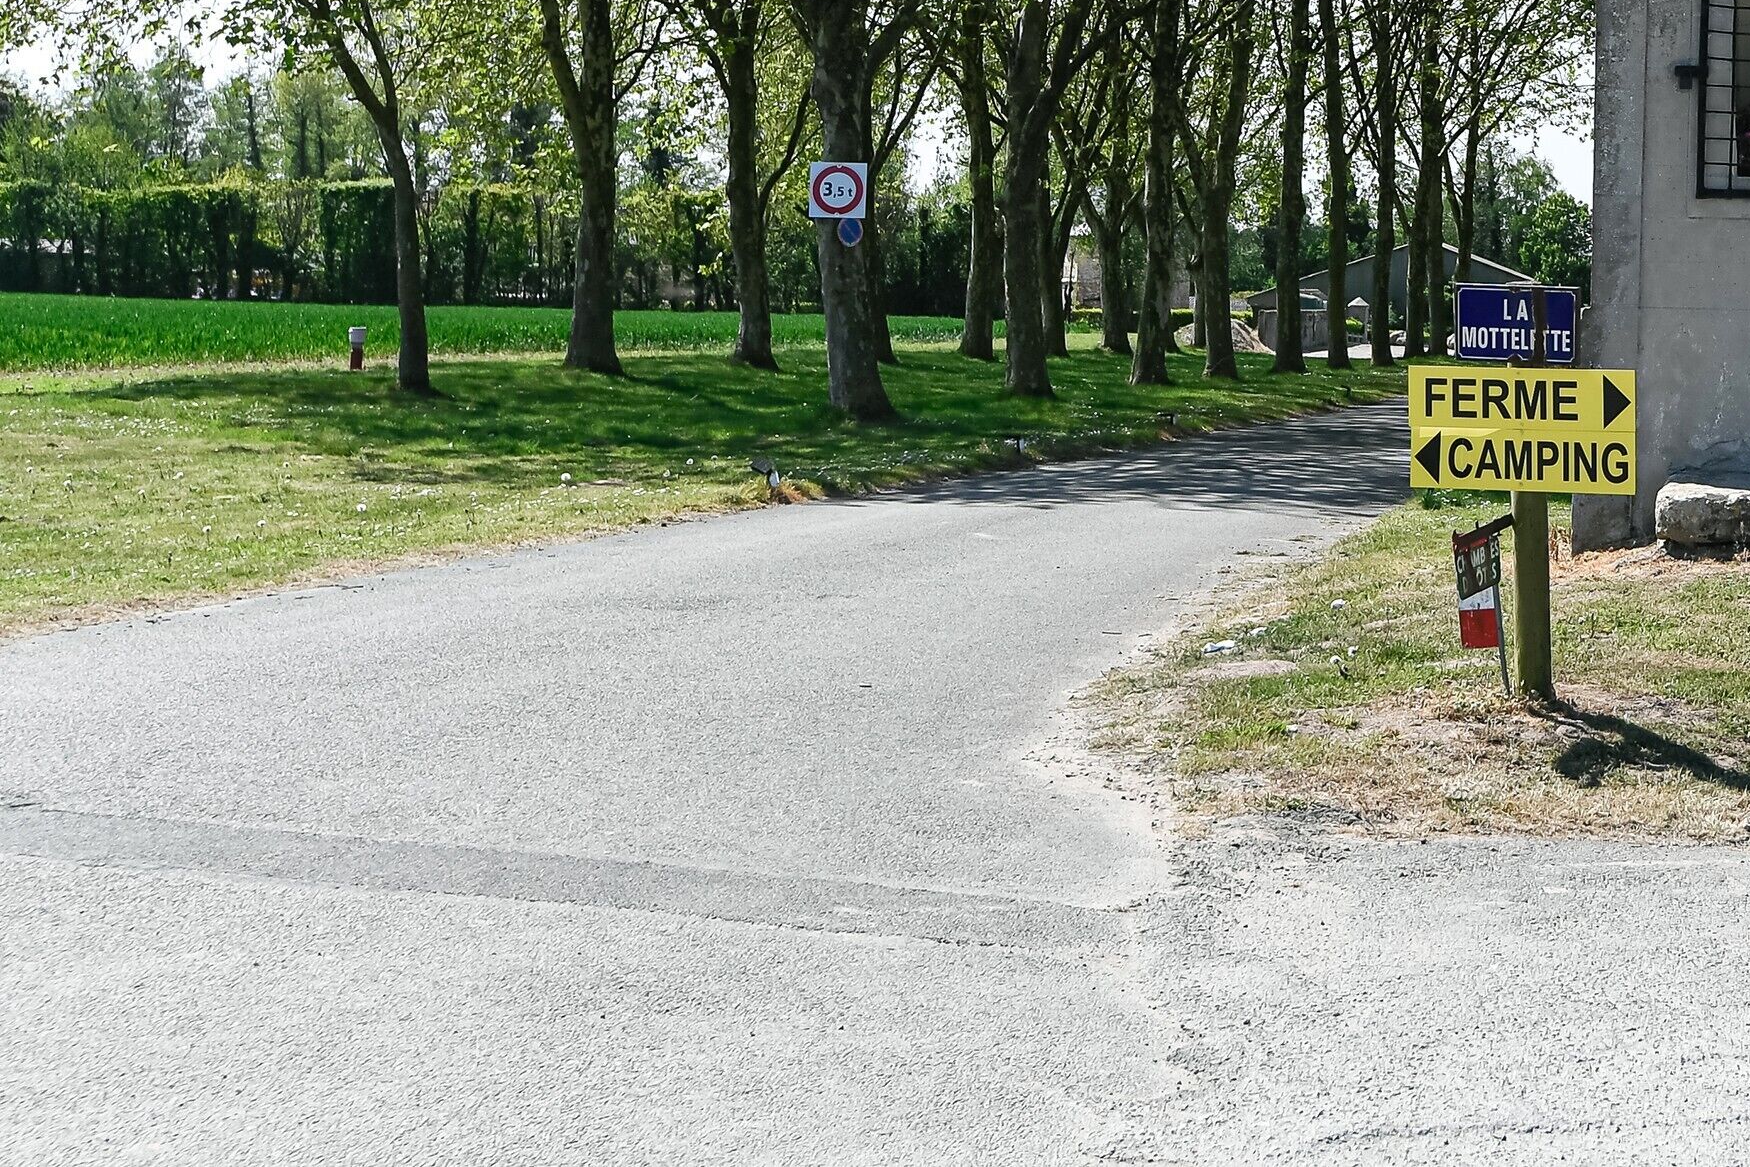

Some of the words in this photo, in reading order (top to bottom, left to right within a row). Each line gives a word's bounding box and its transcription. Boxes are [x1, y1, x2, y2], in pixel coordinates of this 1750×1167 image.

[823, 182, 845, 198] 3,5
[848, 188, 853, 197] t
[1503, 299, 1528, 321] LA
[1424, 377, 1579, 421] FERME
[1449, 437, 1629, 484] CAMPING
